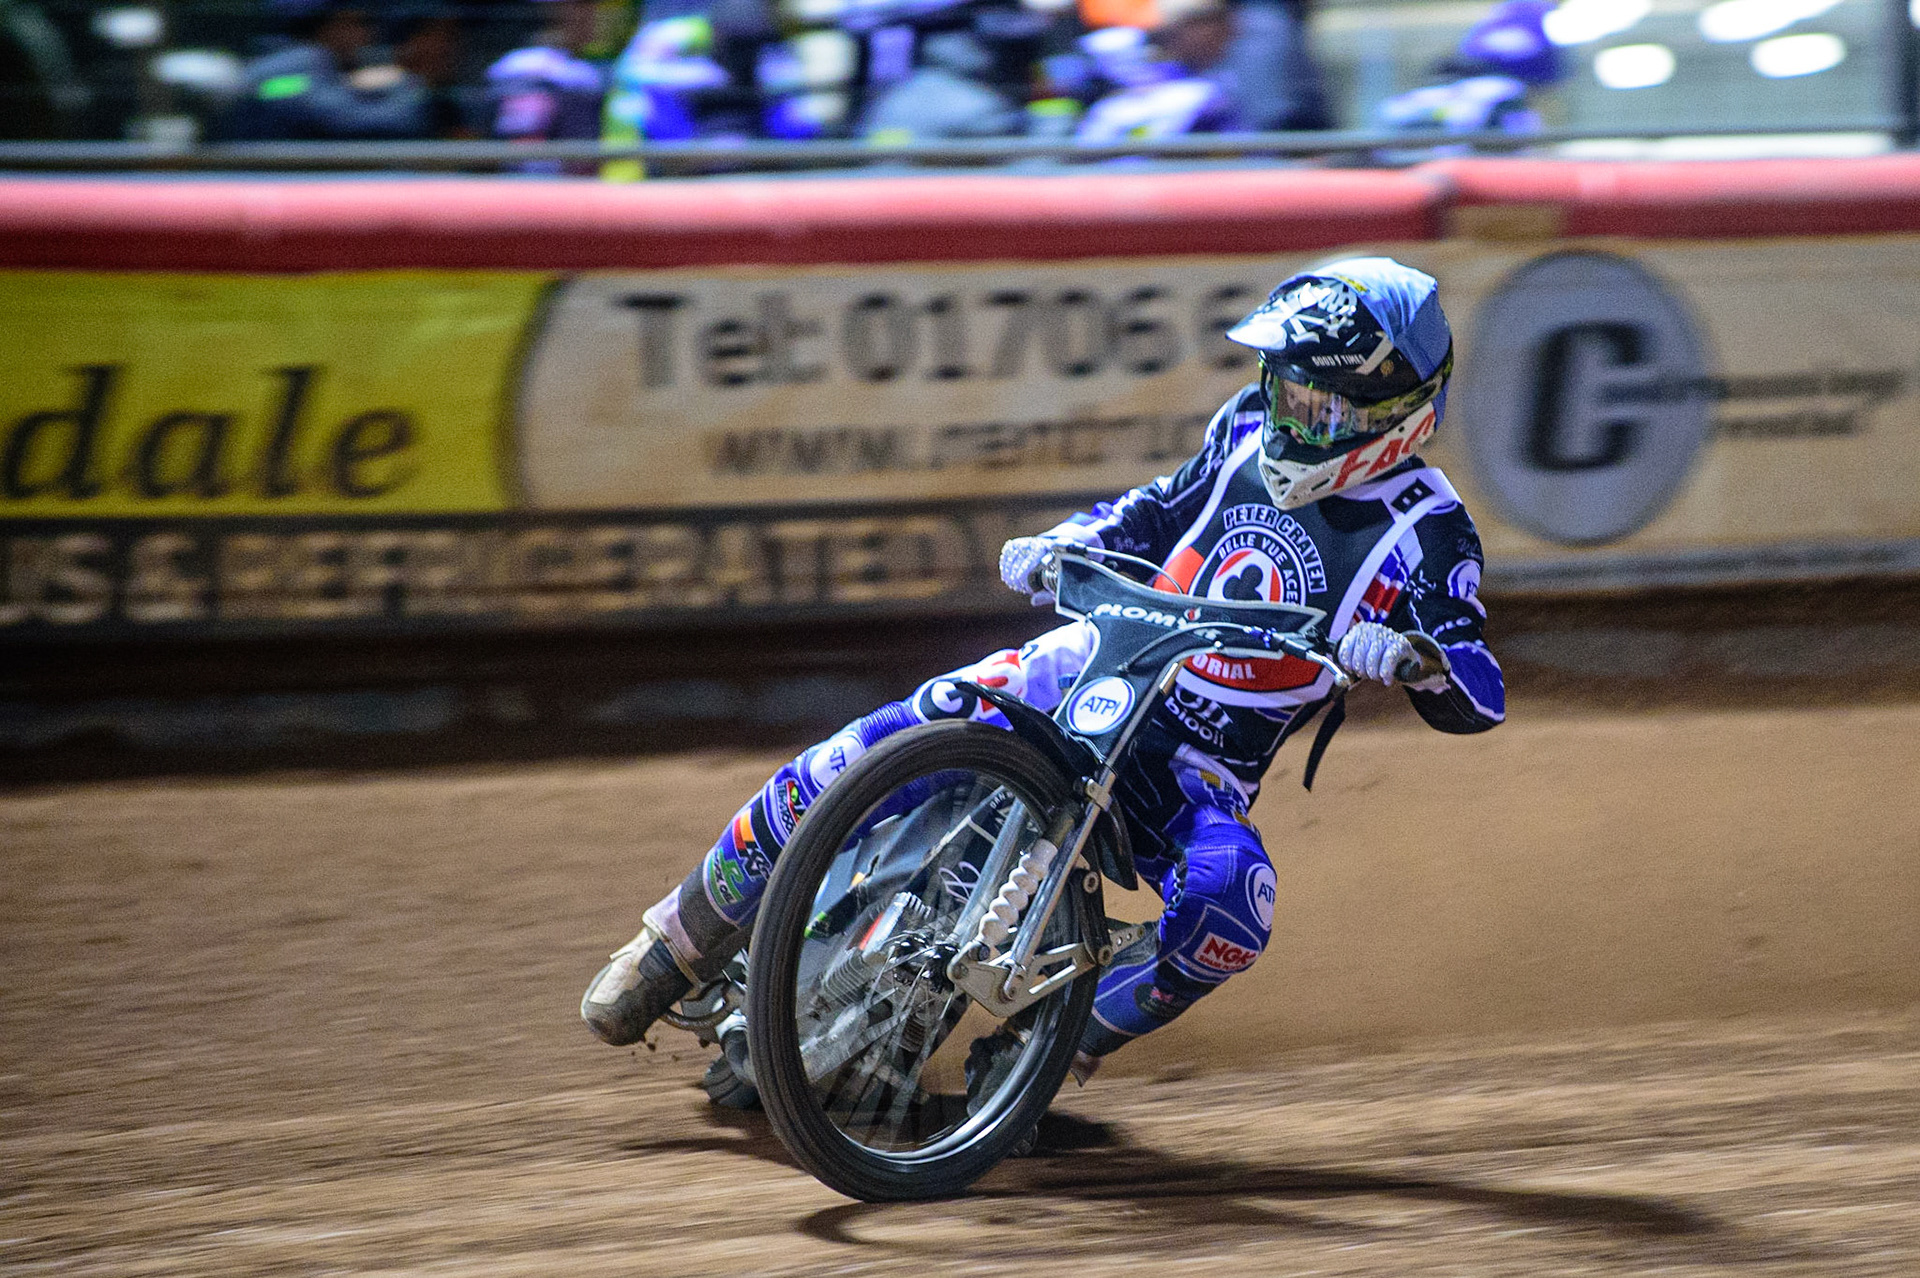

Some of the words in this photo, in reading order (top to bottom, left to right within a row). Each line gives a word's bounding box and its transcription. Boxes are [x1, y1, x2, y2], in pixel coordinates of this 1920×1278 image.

[2, 360, 424, 502] dale
[1218, 534, 1257, 560] BELLE
[1261, 537, 1288, 566] VUE
[1223, 504, 1280, 531] PETER
[1276, 514, 1328, 593] CRAVEN
[1191, 652, 1256, 680] ORIAL
[1080, 695, 1121, 717] ATPI
[1203, 937, 1257, 965] NGK
